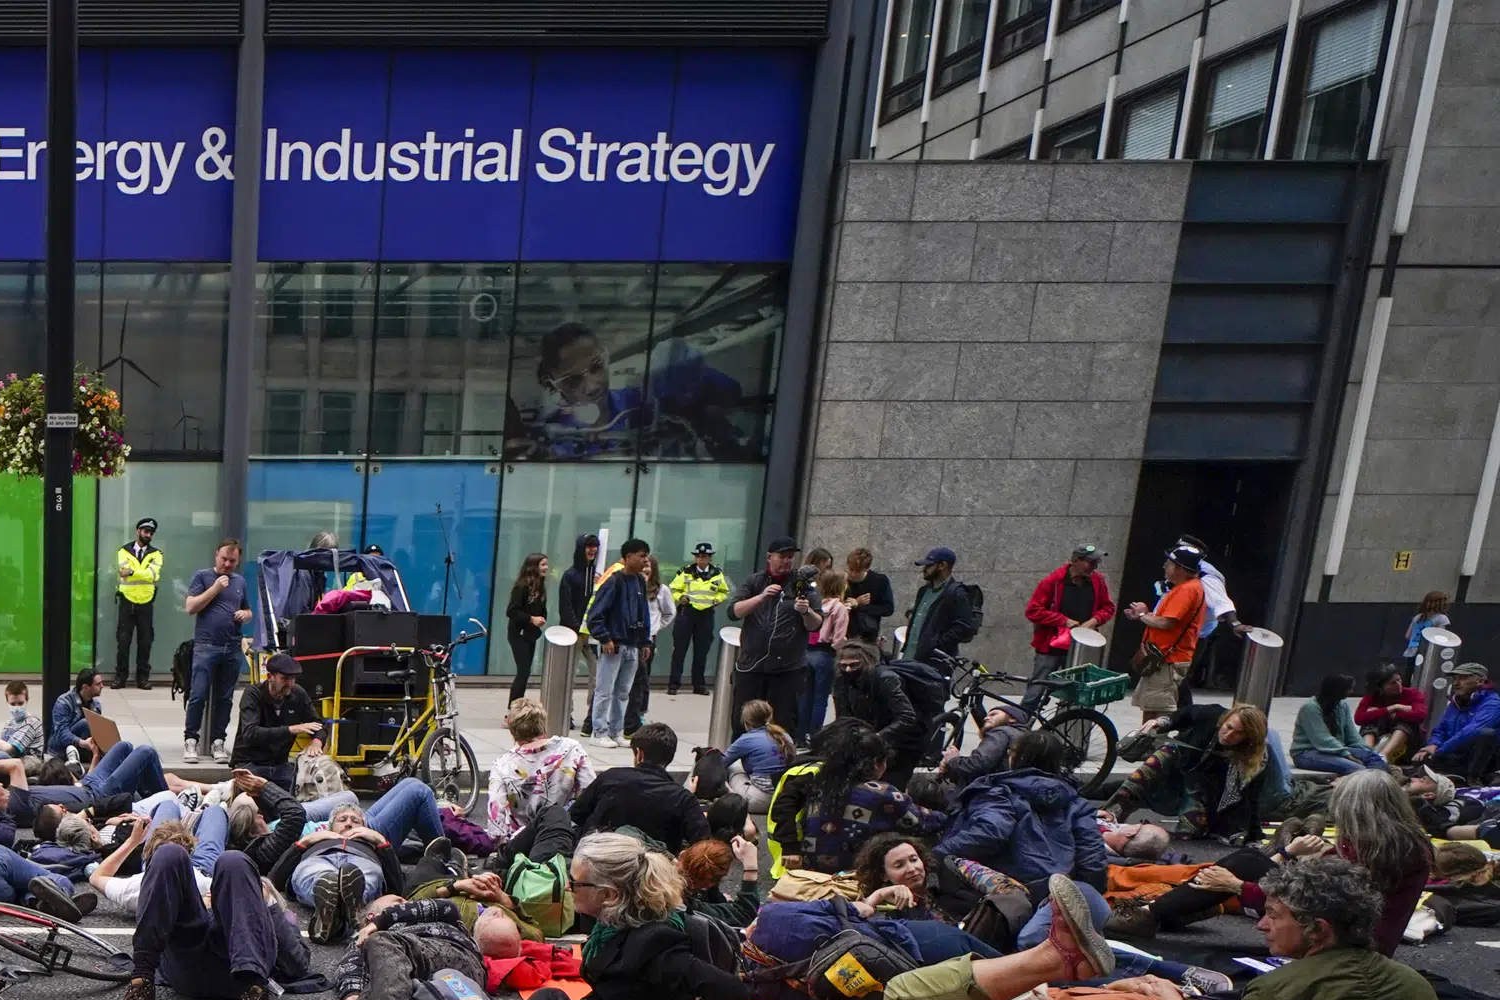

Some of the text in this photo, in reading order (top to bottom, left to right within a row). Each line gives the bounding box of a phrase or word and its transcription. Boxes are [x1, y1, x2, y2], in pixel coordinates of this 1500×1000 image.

[196, 126, 235, 182] &
[266, 127, 523, 182] Industrial
[536, 127, 776, 196] Strategy
[1395, 552, 1410, 569] H
